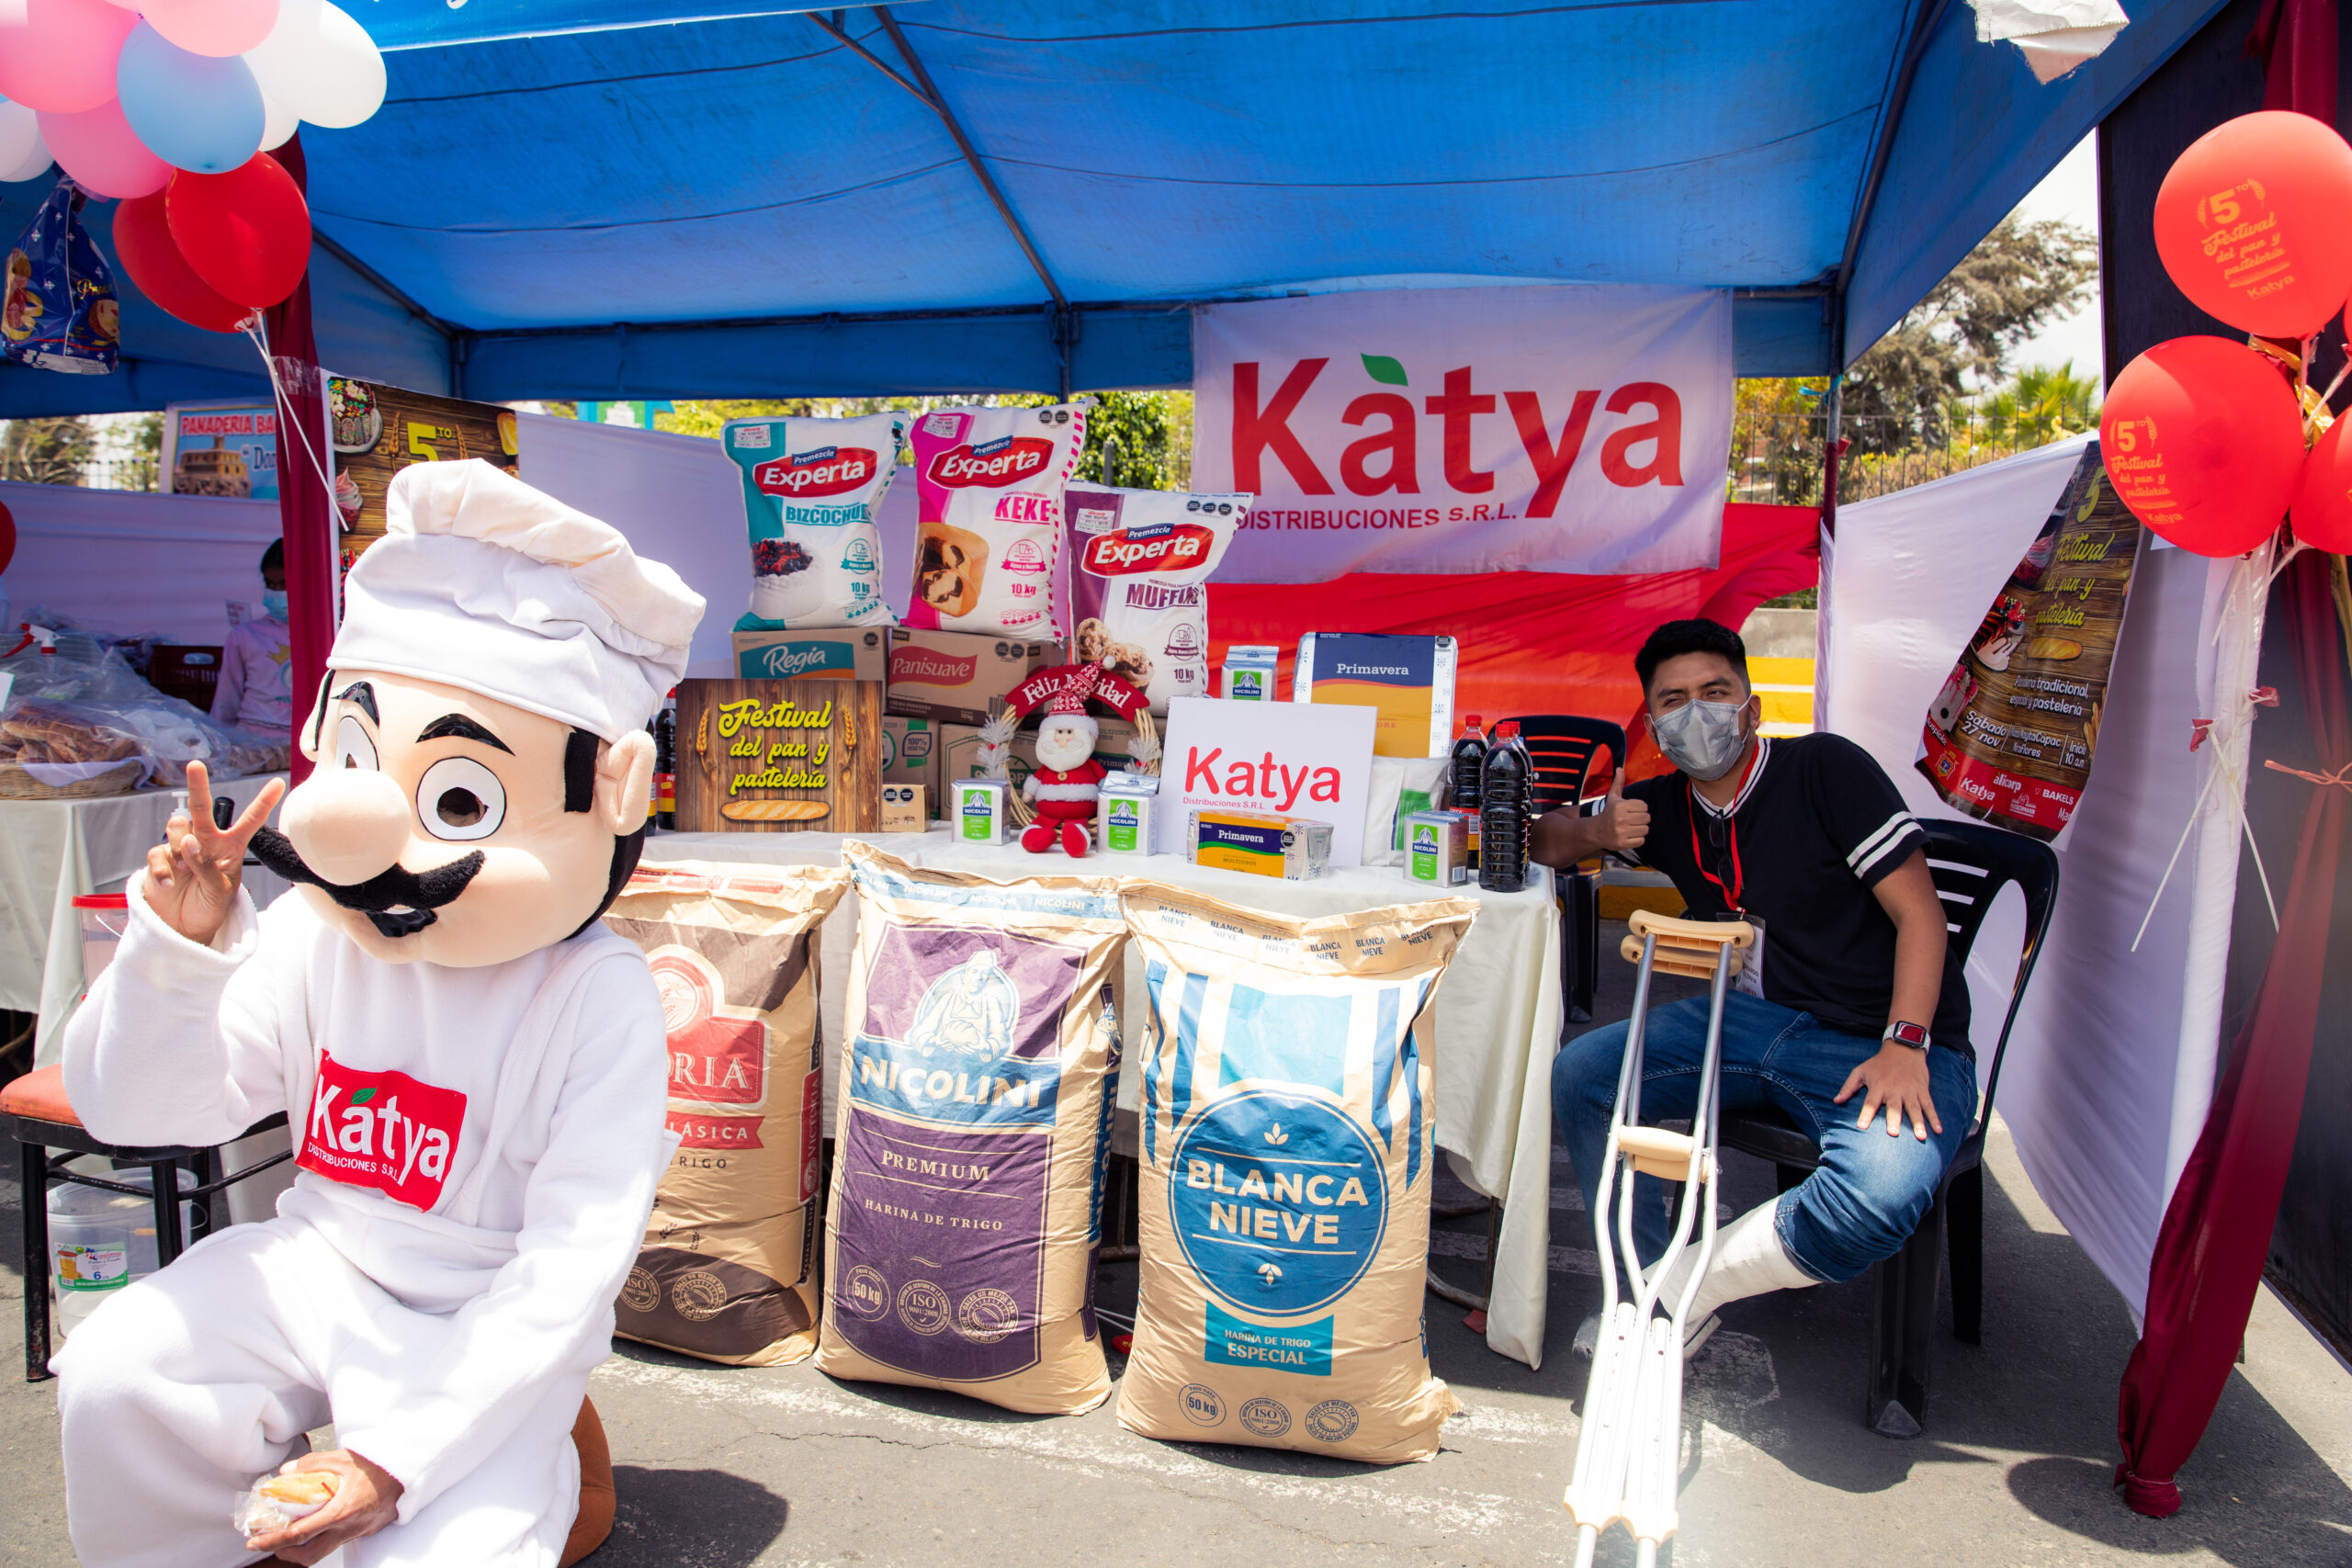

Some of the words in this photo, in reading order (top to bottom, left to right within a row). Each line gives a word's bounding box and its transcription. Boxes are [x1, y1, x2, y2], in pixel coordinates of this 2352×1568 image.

[2201, 211, 2277, 256] Festival
[2216, 248, 2234, 264] del
[2240, 240, 2266, 258] pan
[2271, 232, 2281, 247] y
[2246, 275, 2295, 299] Katya
[1232, 357, 1685, 519] Katya
[793, 449, 835, 466] Premezcla
[940, 450, 1041, 479] Experta
[2110, 453, 2164, 474] Festival
[763, 460, 865, 491] Experta
[2134, 475, 2154, 487] pan
[2158, 474, 2165, 485] y
[786, 503, 871, 525] BIZCOCHUE
[995, 496, 1051, 522] KEKE
[1449, 502, 1518, 524] S.R.L.
[1128, 525, 1171, 539] Premezcla
[1094, 534, 1200, 568] Experta
[851, 581, 860, 592] 10
[862, 581, 870, 593] kg
[1012, 582, 1022, 594] 10
[1024, 583, 1036, 595] kg
[2079, 577, 2096, 601] y
[763, 645, 827, 676] Regia
[892, 657, 970, 678] Panisuave
[1336, 662, 1409, 676] Primavera
[1174, 668, 1183, 680] 10
[1185, 668, 1194, 680] kg
[1022, 676, 1061, 706] Feliz
[1233, 687, 1260, 696] NICOLINI
[718, 699, 832, 738] Festival
[1966, 710, 2007, 738] Sábado
[1961, 720, 1978, 736] 27
[1978, 732, 2001, 747] nov
[729, 735, 762, 757] del
[767, 742, 808, 764] pan
[813, 743, 830, 765] y
[2064, 752, 2075, 764] 10
[729, 766, 828, 795] pastelería
[1185, 746, 1341, 812] Katya
[1993, 773, 2022, 794] alicorp
[1961, 777, 1996, 801] Katya
[2042, 788, 2075, 806] BAKELS
[1182, 796, 1241, 809] Distribuciones
[965, 807, 991, 816] NICOLINI
[1110, 818, 1137, 827] NICOLINI
[1217, 829, 1264, 843] Primavera
[1413, 843, 1437, 853] NICOLINI
[903, 884, 952, 899] NICOLINI
[969, 894, 1018, 906] NICOLINI
[1035, 897, 1086, 911] NICOLINI
[1159, 905, 1193, 921] BLANCA
[1160, 914, 1185, 928] NIEVE
[1209, 920, 1244, 935] BLANCA
[1213, 930, 1238, 942] NIEVE
[1261, 933, 1296, 948] BLANCA
[1310, 941, 1342, 953] BLANCA
[1355, 936, 1385, 950] BLANCA
[1408, 930, 1434, 947] NIEVE
[1265, 944, 1291, 955] NIEVE
[1316, 950, 1340, 961] NIEVE
[1362, 945, 1384, 957] NIEVE
[861, 1055, 1042, 1108] NICOLINI
[311, 1073, 450, 1187] Katya
[308, 1141, 378, 1174] DISTRIBUCIONES
[678, 1156, 728, 1168] RIGO
[881, 1149, 990, 1180] PREMIUM
[1187, 1157, 1369, 1207] BLANCA
[865, 1198, 919, 1221] HARINA
[924, 1213, 945, 1226] DE
[950, 1217, 1003, 1231] TRIGO
[1209, 1201, 1340, 1245] NIEVE
[93, 1270, 101, 1280] 6
[854, 1281, 866, 1299] 50
[868, 1286, 880, 1305] kg
[912, 1292, 937, 1309] ISO
[988, 1290, 1009, 1303] MEJOR
[908, 1305, 939, 1318] 9001:2008
[1225, 1328, 1261, 1344] HARINA
[1264, 1336, 1279, 1346] DE
[1281, 1337, 1311, 1348] TRIGO
[1227, 1342, 1308, 1366] ESPECIAL
[1188, 1396, 1202, 1411] 50
[1203, 1400, 1216, 1416] kg
[1331, 1401, 1350, 1409] MEJOR
[1254, 1408, 1278, 1420] ISO
